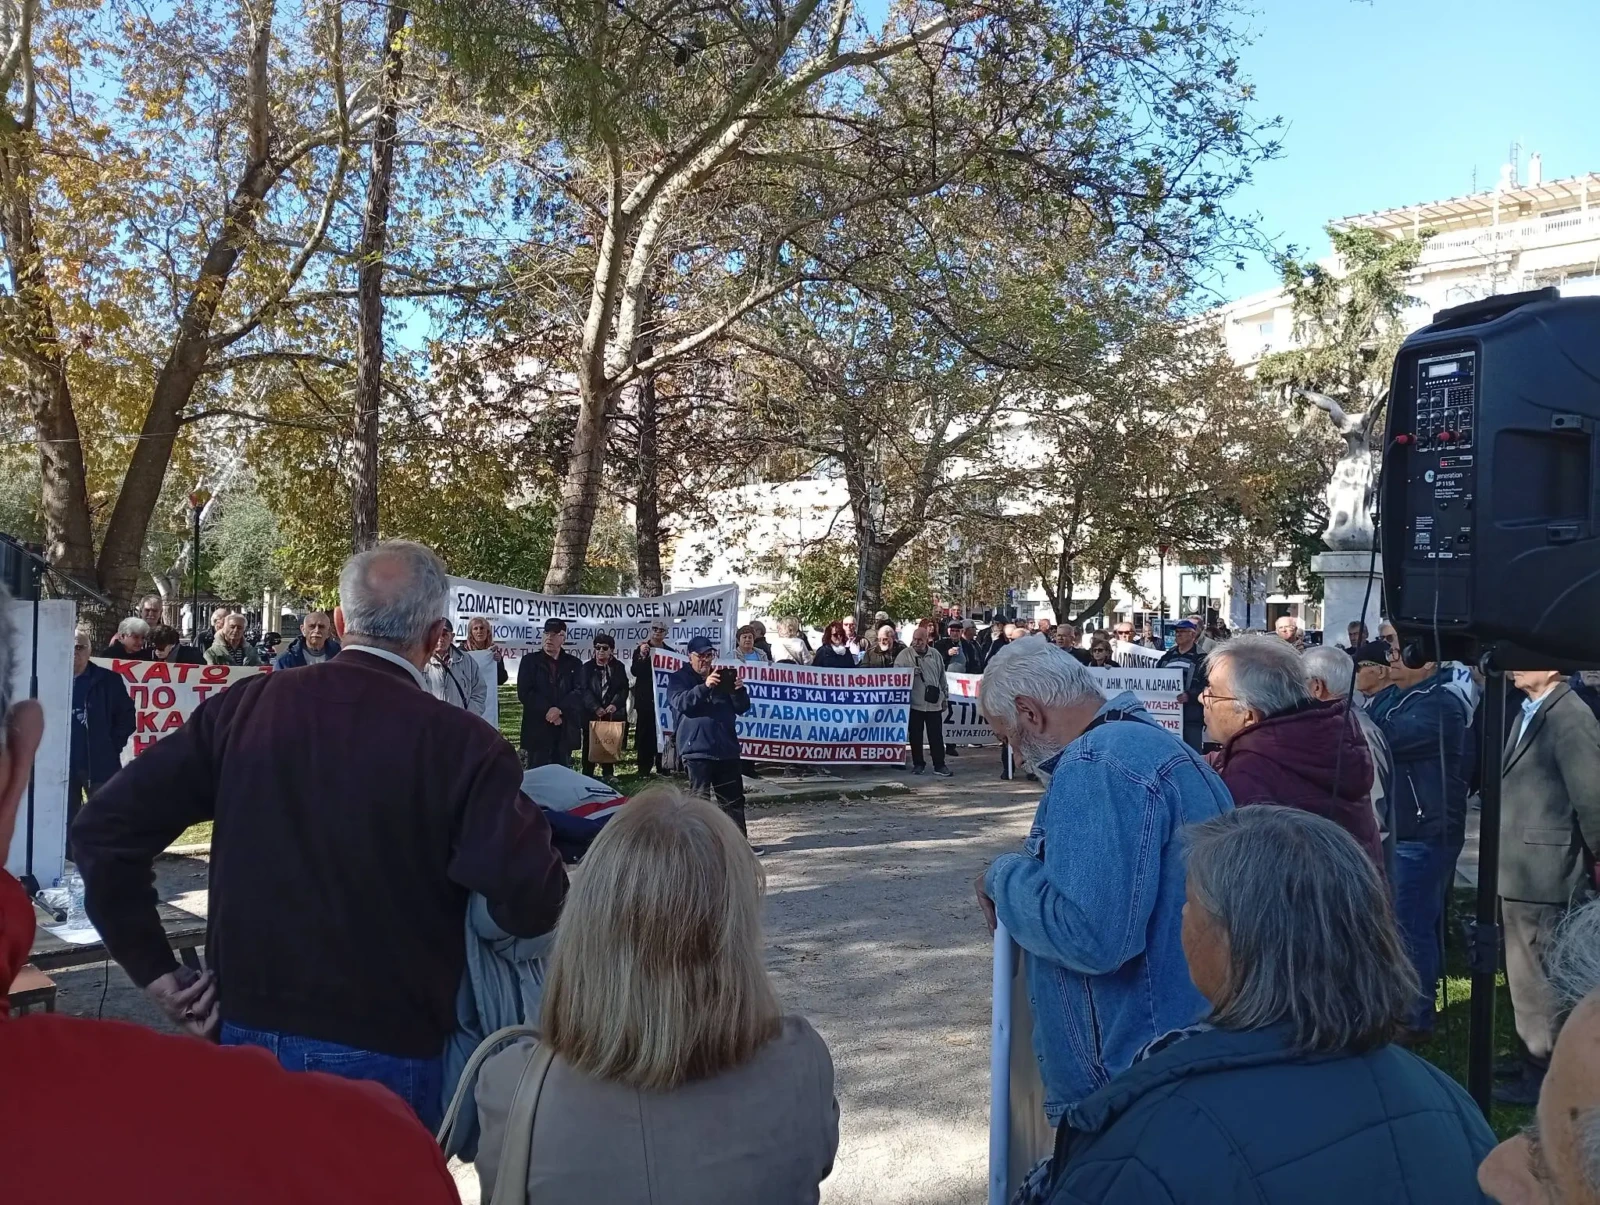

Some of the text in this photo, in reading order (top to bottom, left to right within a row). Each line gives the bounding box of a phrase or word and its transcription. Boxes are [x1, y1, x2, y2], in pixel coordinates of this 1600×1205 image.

[457, 593, 524, 615] ΣΩΜΑΤΕΙΟ
[527, 600, 623, 618] ΣΥΝΤΑΞΙΟΥΧΩΝ
[626, 602, 660, 618] ΟΑΕΕ
[677, 599, 724, 617] ΔΡΑΜΑΣ
[112, 659, 231, 684] ΚΑΤΩ
[738, 665, 911, 687] ΟΤΙ ΑΔΙΚΑ ΜΑΣ ΕΧΕΙ ΑΦΑΙΡΕΘΕΙ
[129, 685, 177, 709] ΠΟ
[771, 687, 780, 699] Η
[805, 689, 827, 702] ΚΑΙ
[852, 691, 911, 703] ΣΥΝΤΑΞΗ
[1144, 700, 1180, 711] ΝΤΑΞΗΣ
[136, 711, 185, 733] ΚΑ
[742, 703, 908, 724] ΑΤΑΒΛΗΘΟΥΝ ΟΛΑ
[735, 721, 803, 741] ΟΥΜΕΝΑ
[807, 726, 906, 742] ΑΝΑΔΡΟΜΙΚΑ
[739, 742, 903, 760] ΝΤΑΞΙΟΥΧΩΝ ΙΚΑ ΕΒΡΟΥ
